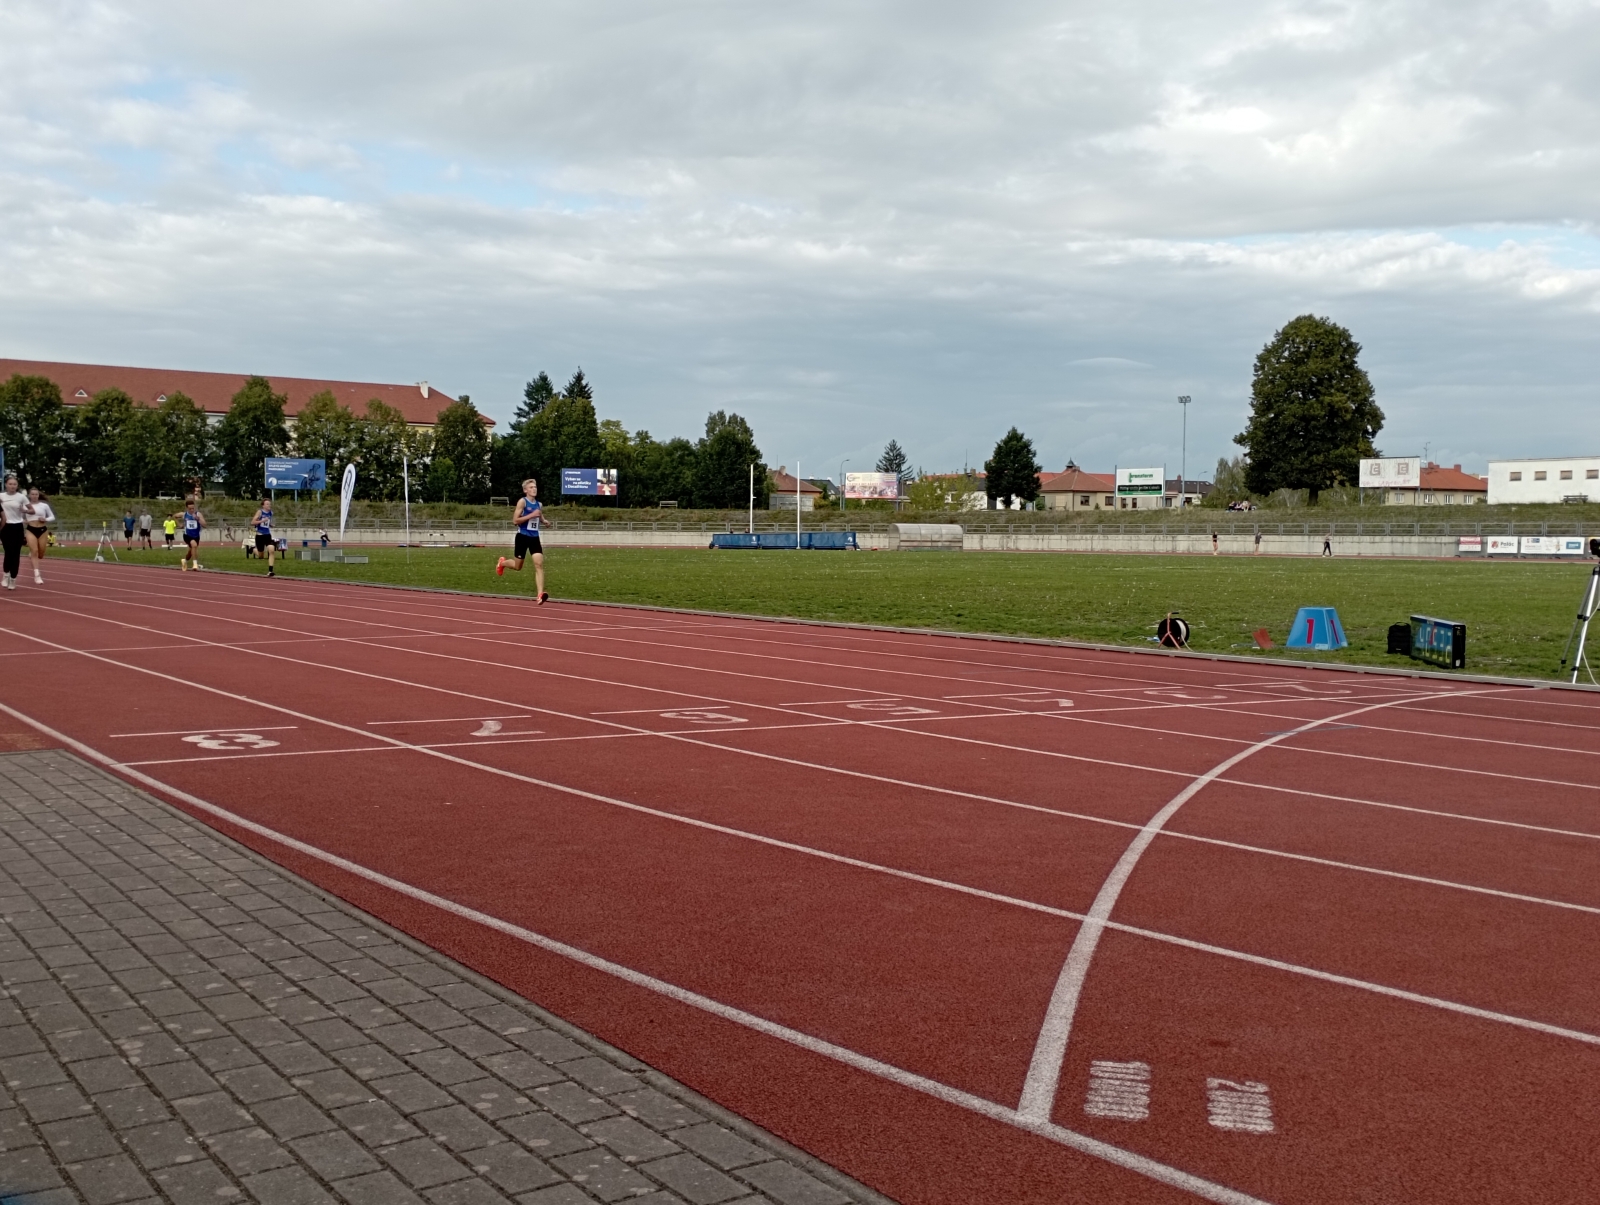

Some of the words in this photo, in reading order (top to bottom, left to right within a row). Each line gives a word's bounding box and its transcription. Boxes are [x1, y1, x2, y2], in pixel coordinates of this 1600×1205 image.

[1306, 618, 1315, 644] 1
[1330, 619, 1341, 644] 1
[181, 733, 281, 750] 8
